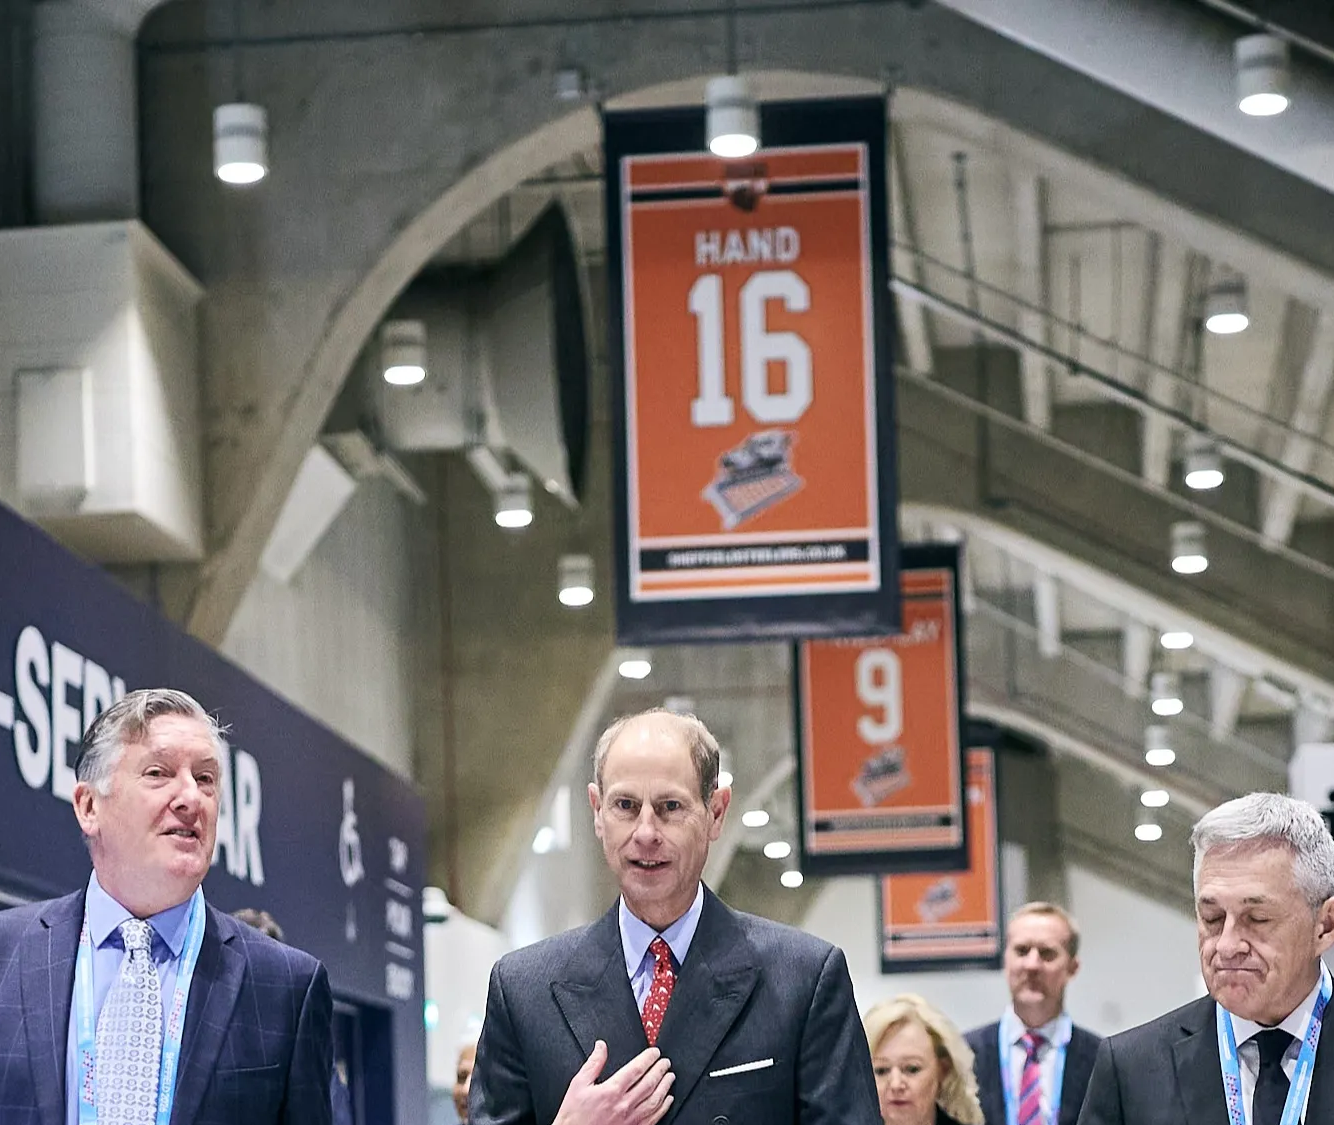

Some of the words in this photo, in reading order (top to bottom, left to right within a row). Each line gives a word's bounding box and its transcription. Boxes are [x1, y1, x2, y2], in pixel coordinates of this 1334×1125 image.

[695, 225, 801, 266] HAND
[688, 269, 814, 428] 16
[854, 646, 903, 744] 9
[212, 738, 265, 887] AR
